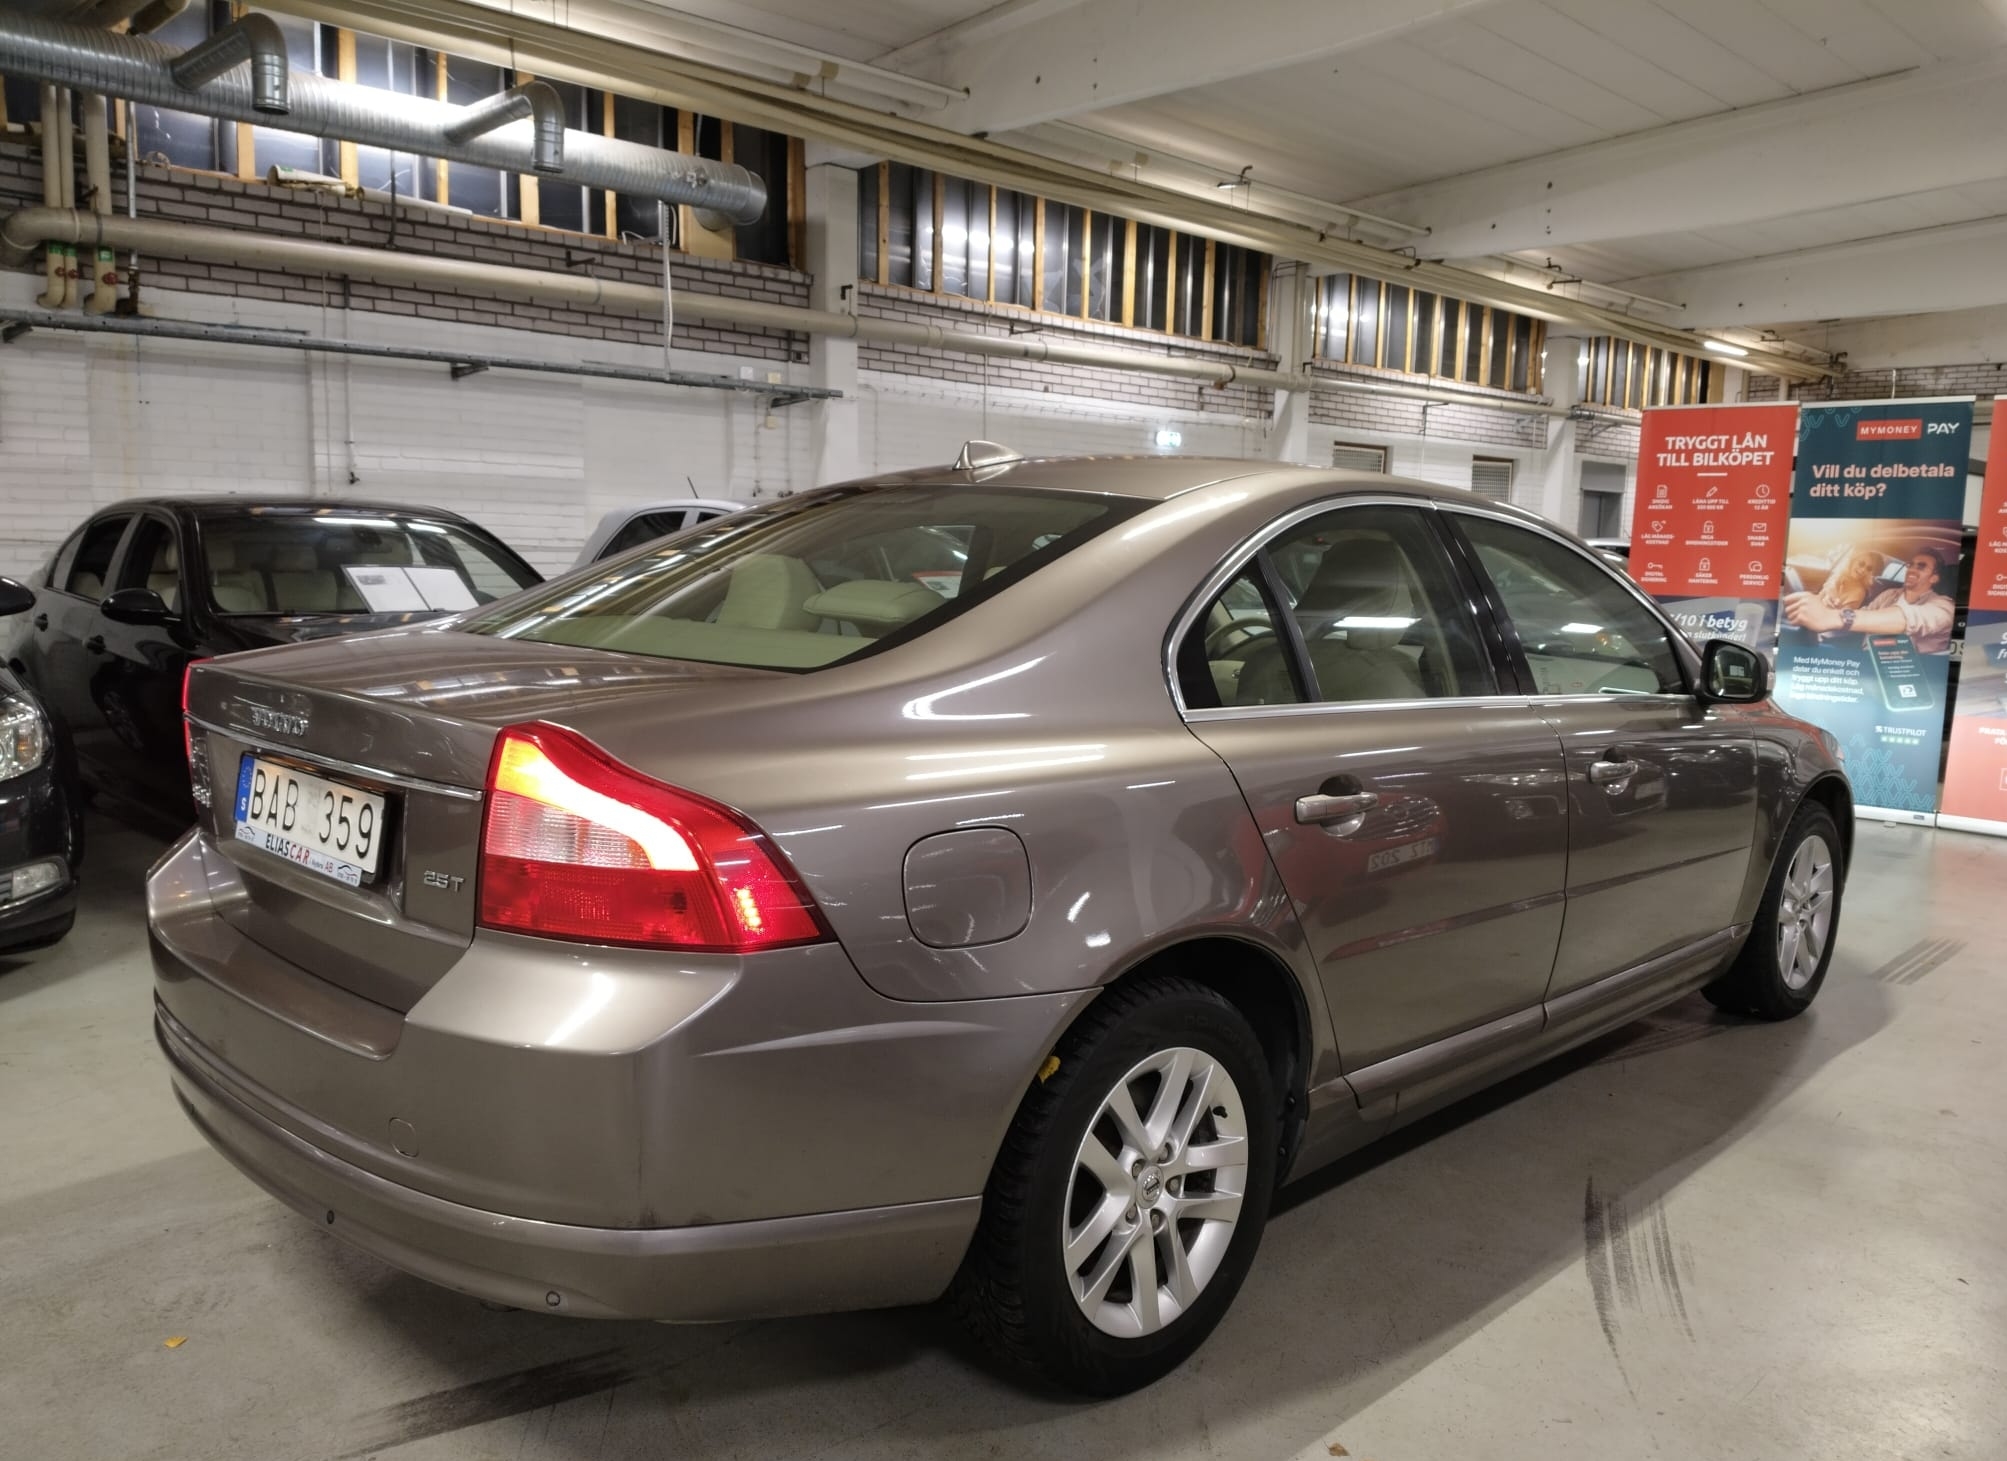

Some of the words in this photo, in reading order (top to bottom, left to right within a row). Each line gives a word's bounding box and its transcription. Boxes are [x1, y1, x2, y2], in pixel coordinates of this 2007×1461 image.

[1860, 425, 1918, 435] MYMONEY
[1927, 422, 1960, 434] PAY
[1665, 435, 1729, 450] TRYGGT
[1732, 432, 1767, 448] LÅN
[1657, 453, 1689, 467] TILL
[1692, 449, 1774, 466] BILKÖPET
[1812, 464, 1840, 478] Vill
[1843, 464, 1866, 478] du
[1870, 463, 1955, 478] delbetala
[1810, 483, 1840, 497] ditt
[1844, 482, 1887, 500] köp?
[1707, 614, 1749, 631] betyg
[1811, 657, 1846, 667] MyMoney
[1884, 726, 1927, 736] TRUSTPILOT
[250, 768, 299, 831] BAB
[319, 790, 374, 859] 359
